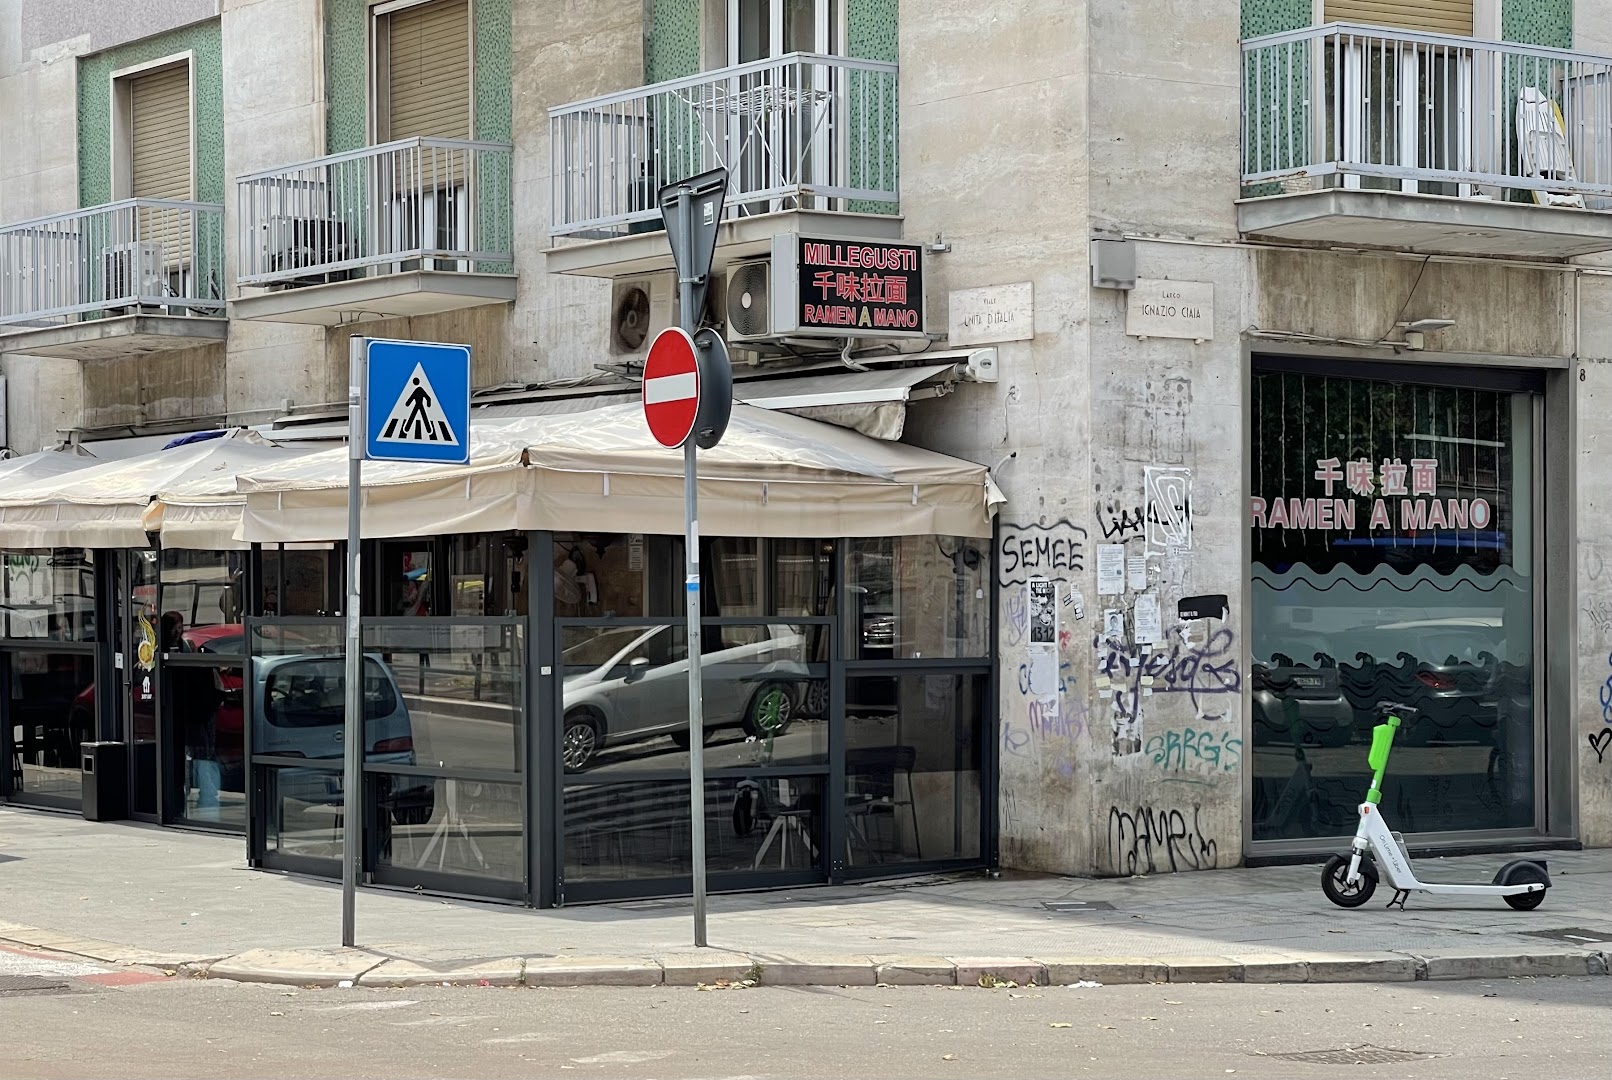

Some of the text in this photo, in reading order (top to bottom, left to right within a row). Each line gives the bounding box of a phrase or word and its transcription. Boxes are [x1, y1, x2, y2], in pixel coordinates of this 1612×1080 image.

[804, 243, 917, 271] MILLEGUSTI
[813, 271, 908, 305] 千味拉面
[804, 304, 918, 328] RAMEN A MANO
[1142, 304, 1201, 319] IGNAZIO CIAIA
[1580, 368, 1586, 382] 8
[1315, 457, 1438, 495] 千味拉面
[1250, 496, 1490, 529] RAMEN A MANO
